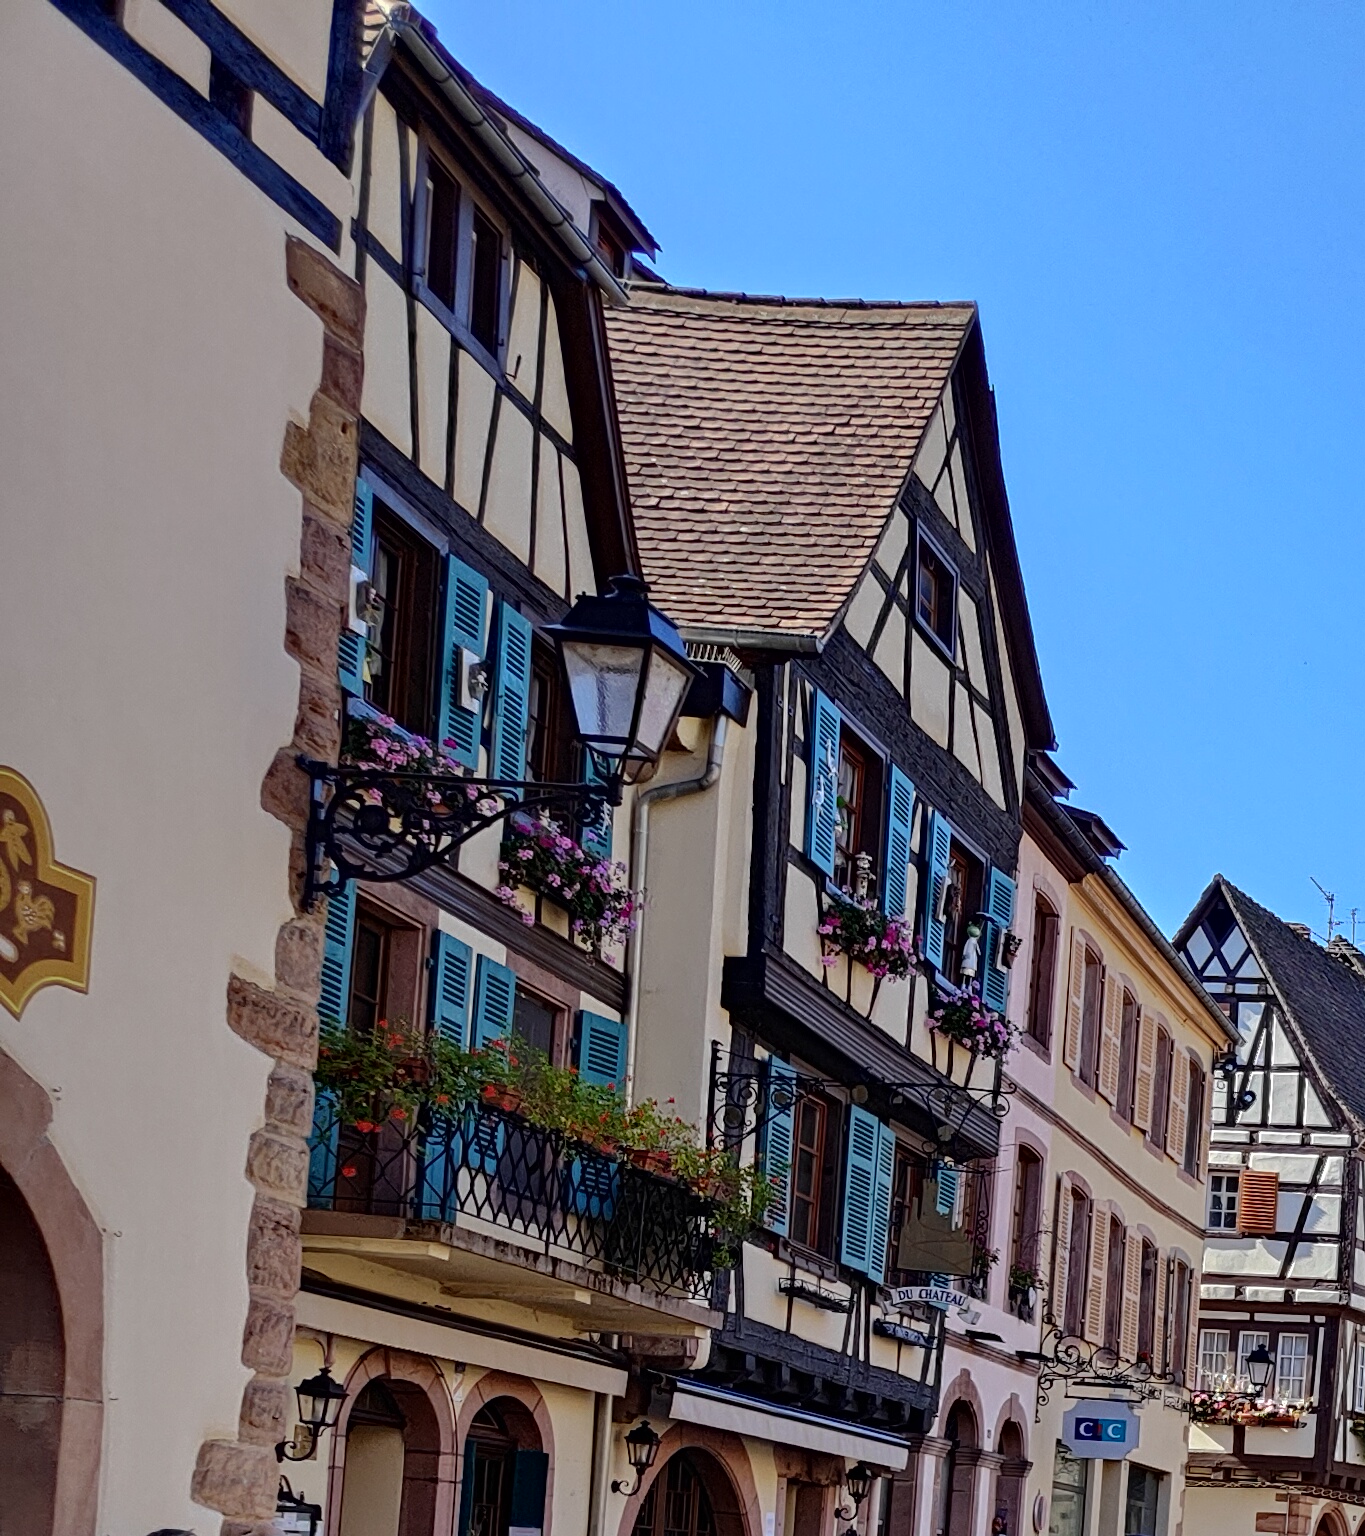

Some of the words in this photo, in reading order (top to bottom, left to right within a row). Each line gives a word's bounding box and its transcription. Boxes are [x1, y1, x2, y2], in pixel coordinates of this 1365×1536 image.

[898, 1288, 914, 1301] DU
[918, 1288, 967, 1307] CHATEAU
[1078, 1421, 1122, 1439] CIC
